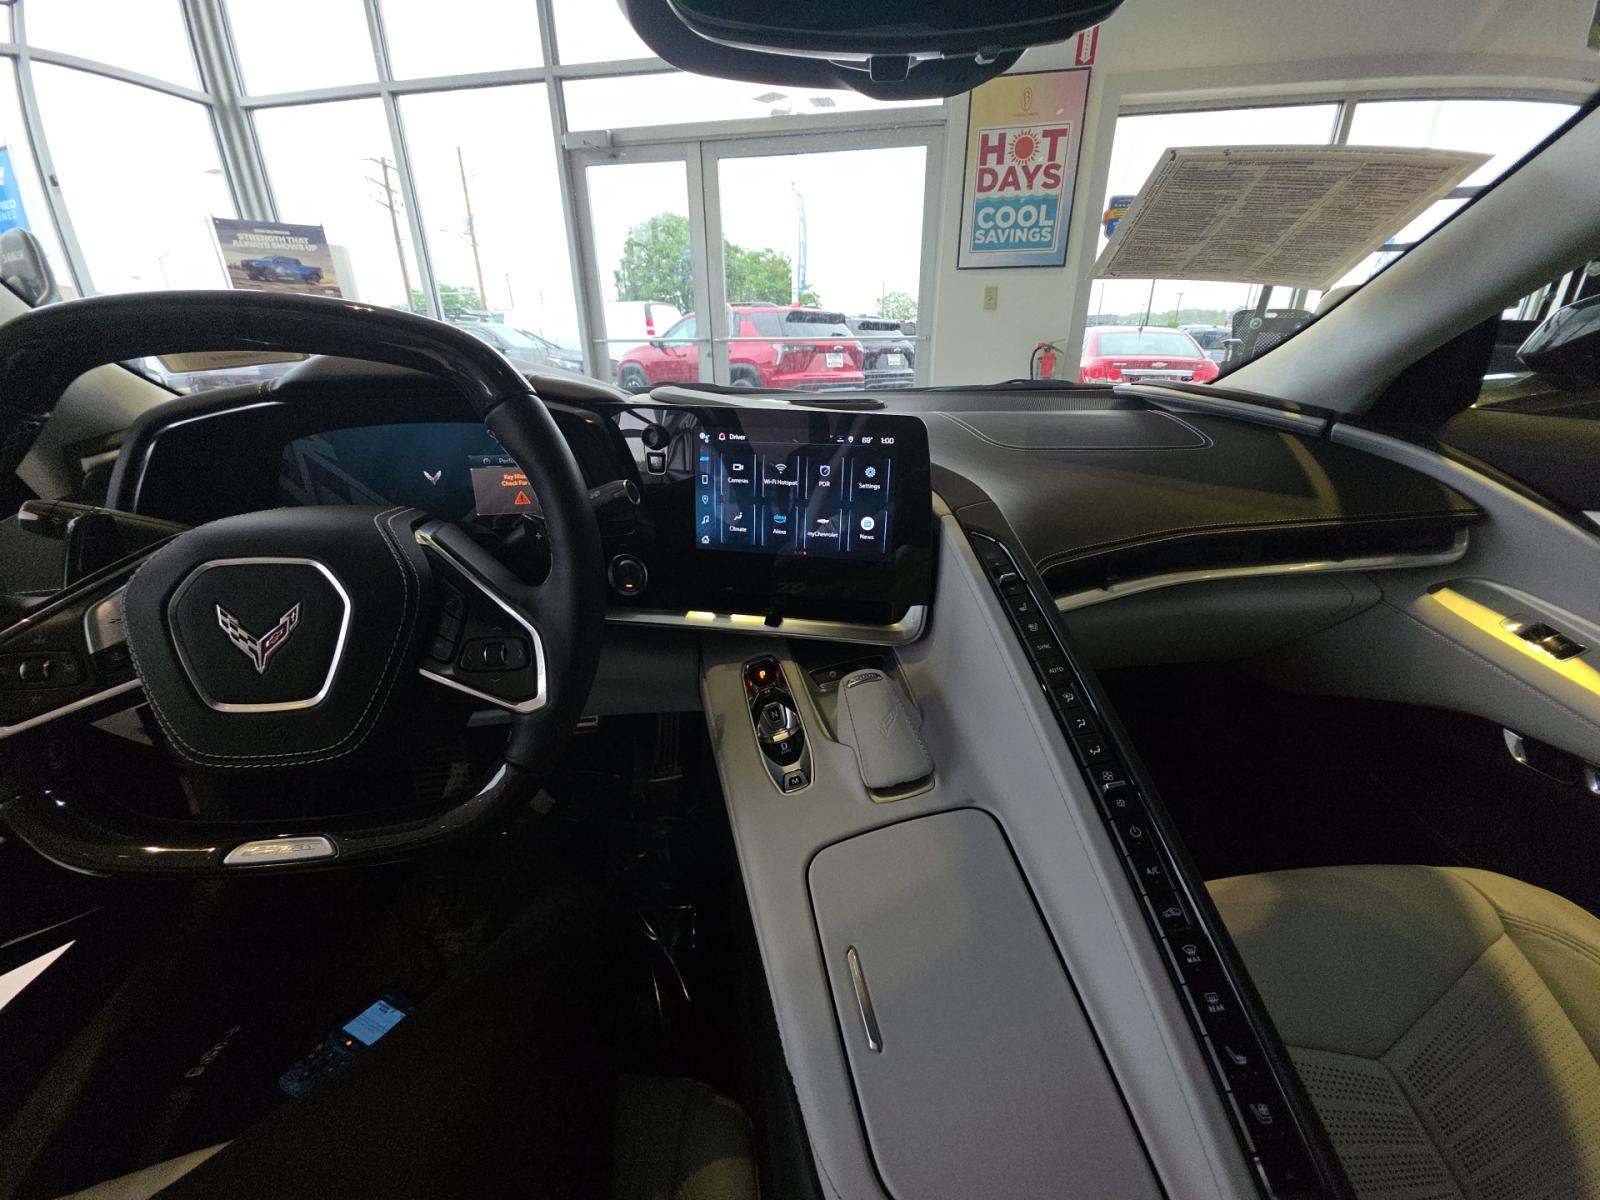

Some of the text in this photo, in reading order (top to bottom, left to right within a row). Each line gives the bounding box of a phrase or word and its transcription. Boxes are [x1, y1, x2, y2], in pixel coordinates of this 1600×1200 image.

[976, 163, 1062, 193] DAYS
[977, 204, 1054, 229] COOL
[237, 233, 309, 244] STRENGTH THAT
[974, 228, 1051, 244] SAVINGS
[233, 240, 270, 249] ALWAYS
[307, 244, 318, 252] UP
[778, 479, 799, 487] Hotspot
[759, 670, 767, 679] P
[1049, 666, 1063, 674] AUTO
